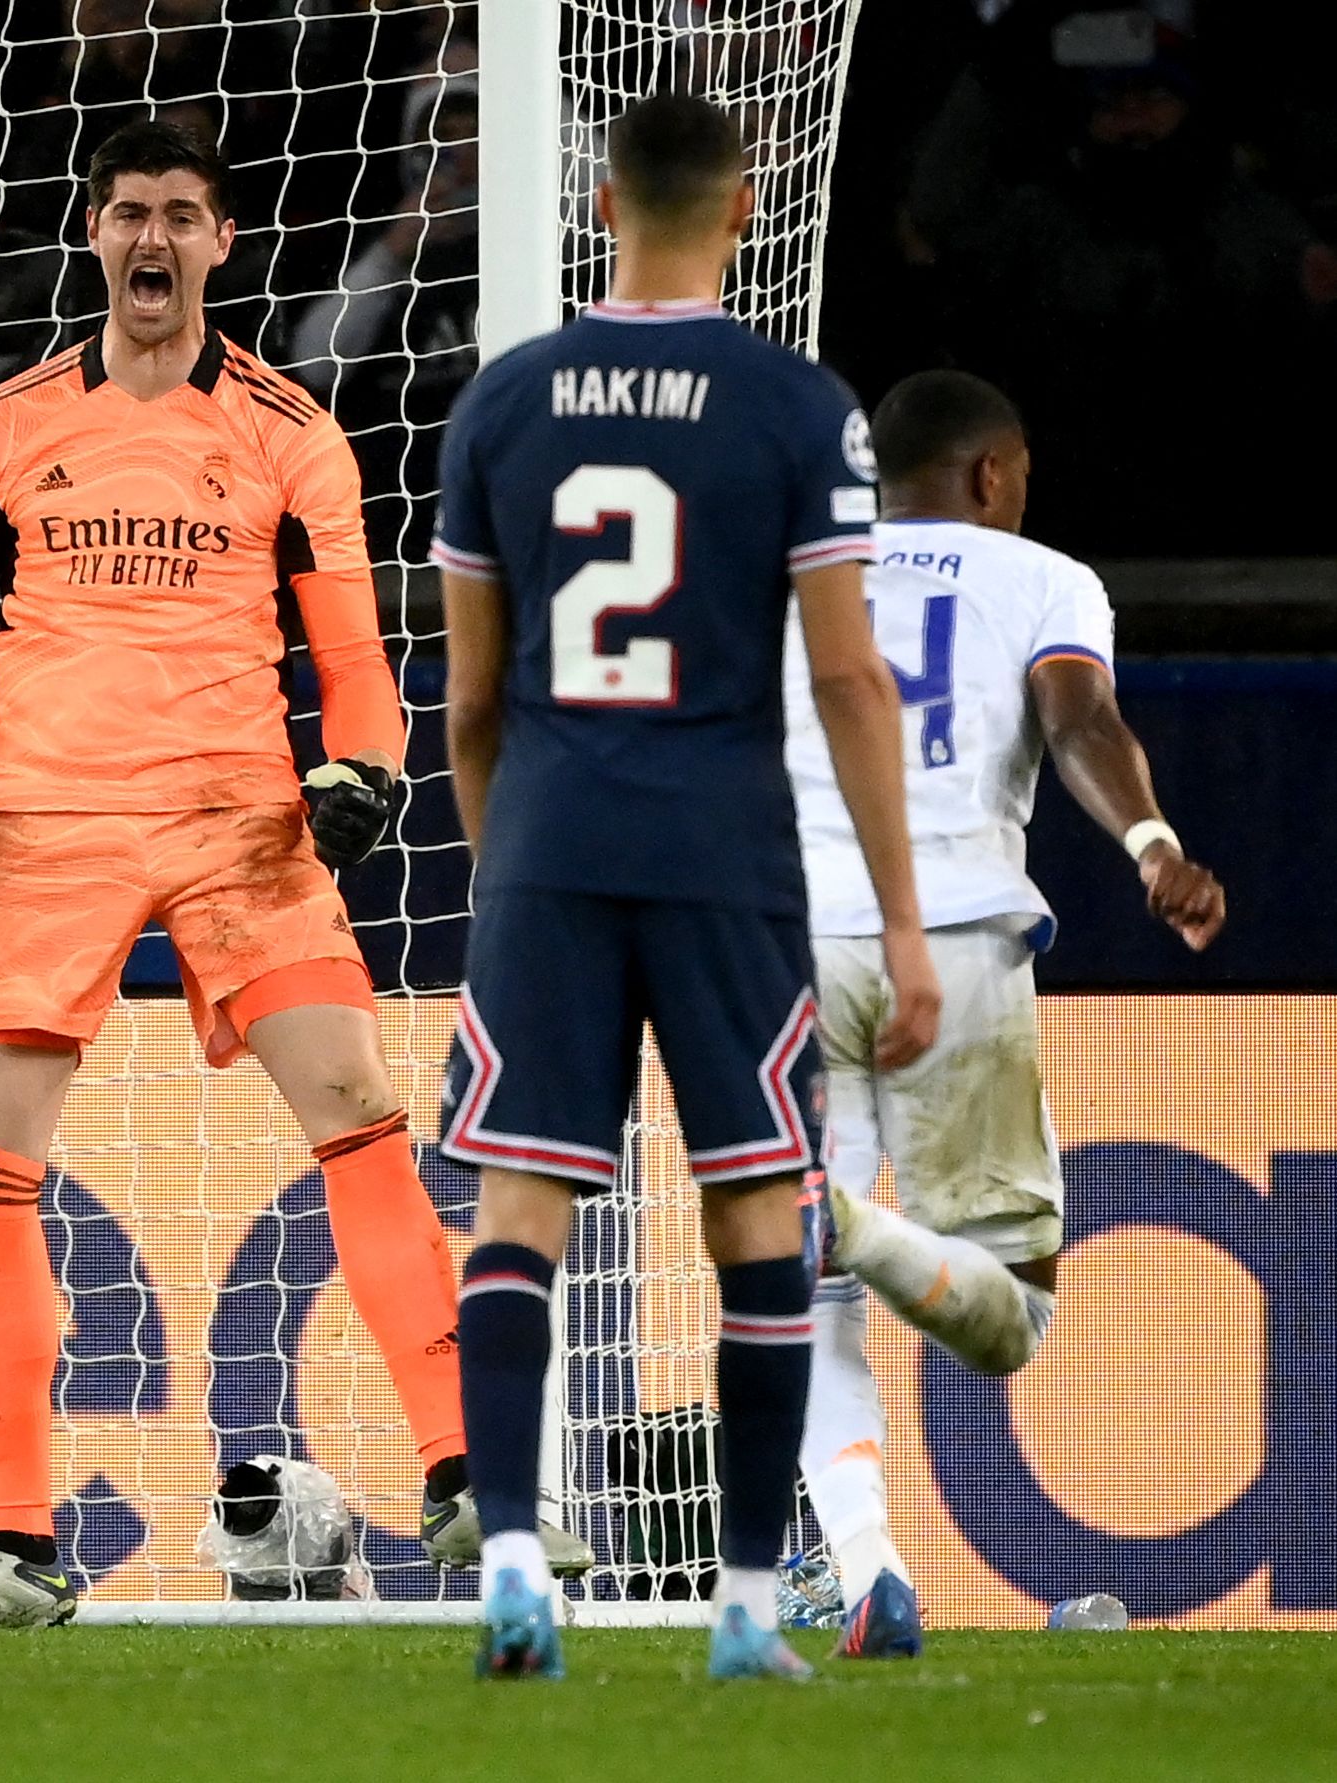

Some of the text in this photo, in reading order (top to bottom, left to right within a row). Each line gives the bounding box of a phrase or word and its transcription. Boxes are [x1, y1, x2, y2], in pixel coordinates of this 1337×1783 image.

[551, 366, 711, 422] HAKIMI
[39, 508, 231, 554] Emirates
[68, 553, 198, 588] FLY BETTER
[551, 464, 684, 709] 2
[865, 594, 958, 770] 4
